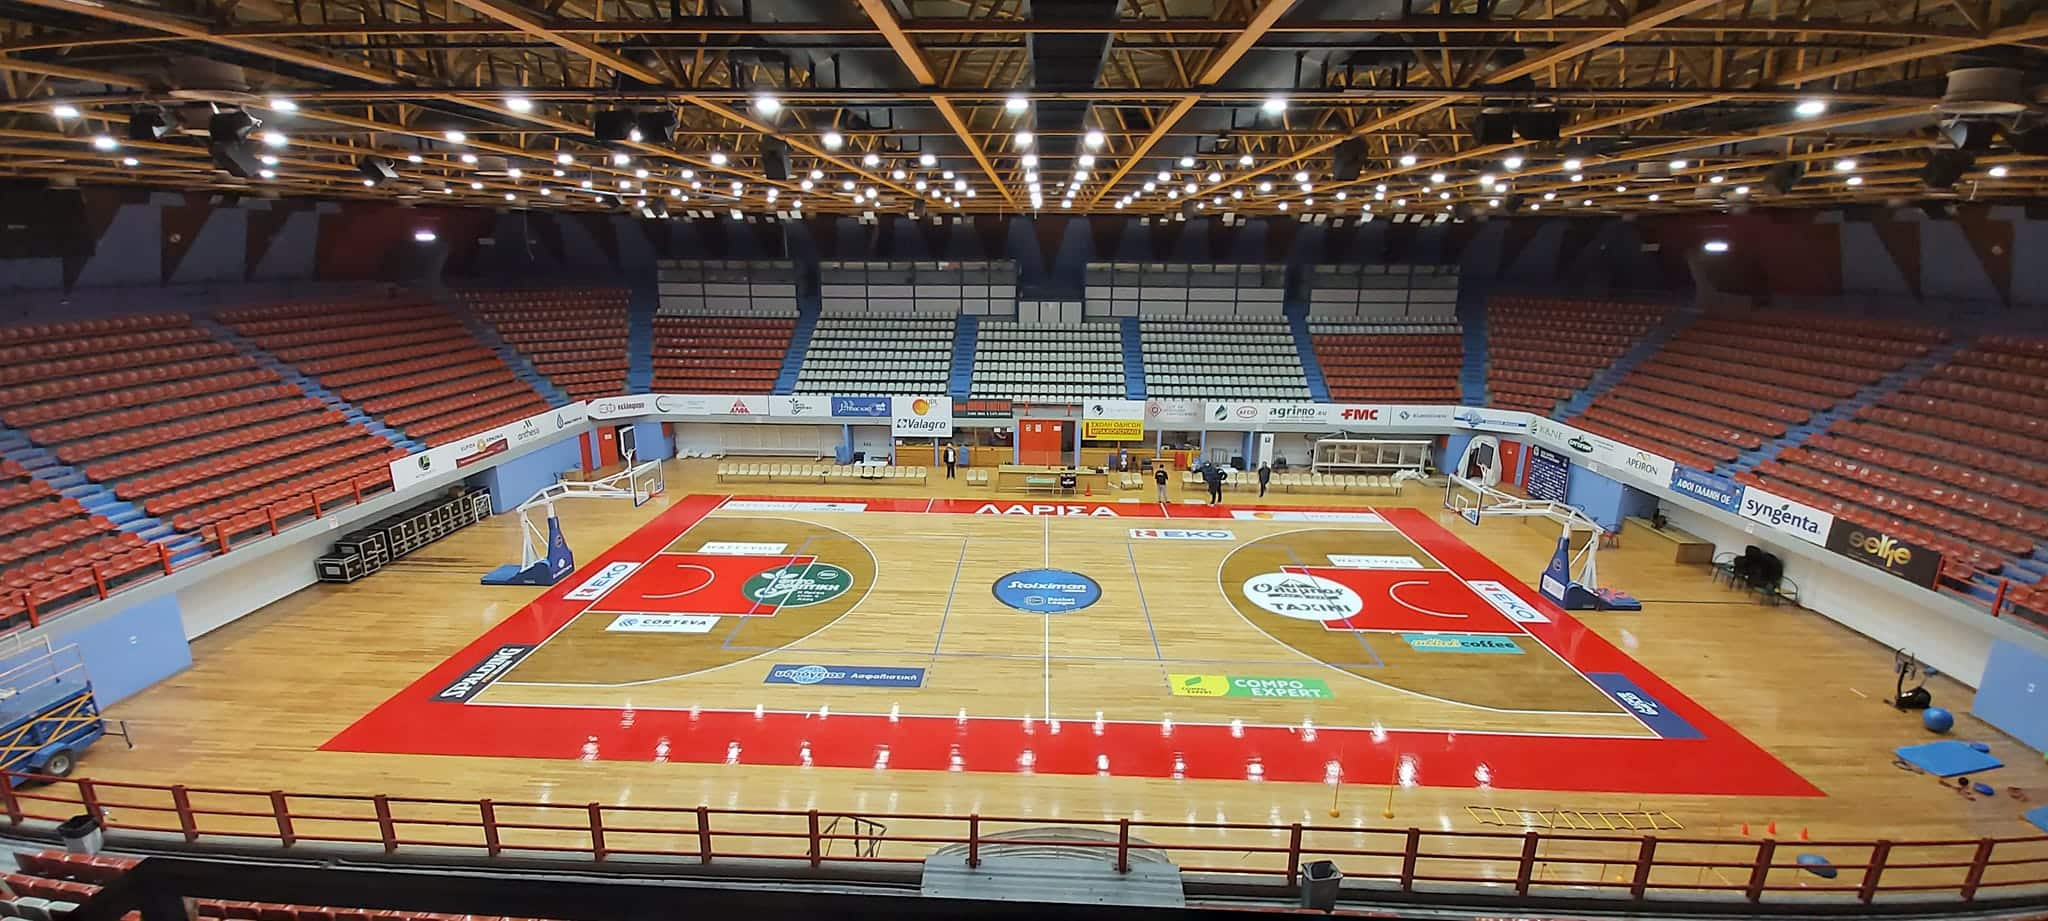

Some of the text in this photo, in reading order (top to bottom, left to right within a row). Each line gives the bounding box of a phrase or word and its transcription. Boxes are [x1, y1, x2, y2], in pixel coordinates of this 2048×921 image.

[1343, 409, 1379, 420] FMC
[908, 419, 946, 431] Valagro
[1626, 457, 1658, 476] APEIRON
[975, 504, 1120, 517] ΛΑΡΙΣΑ
[1746, 498, 1818, 534] syngenta
[1164, 530, 1230, 539] EKO
[591, 563, 629, 587] EKO
[1008, 581, 1087, 590] Stoiximan
[1494, 592, 1536, 620] EKO
[1460, 640, 1515, 649] coffee
[440, 647, 526, 698] SPALDING
[1234, 679, 1304, 689] COMPO
[1251, 687, 1321, 698] EXPERT
